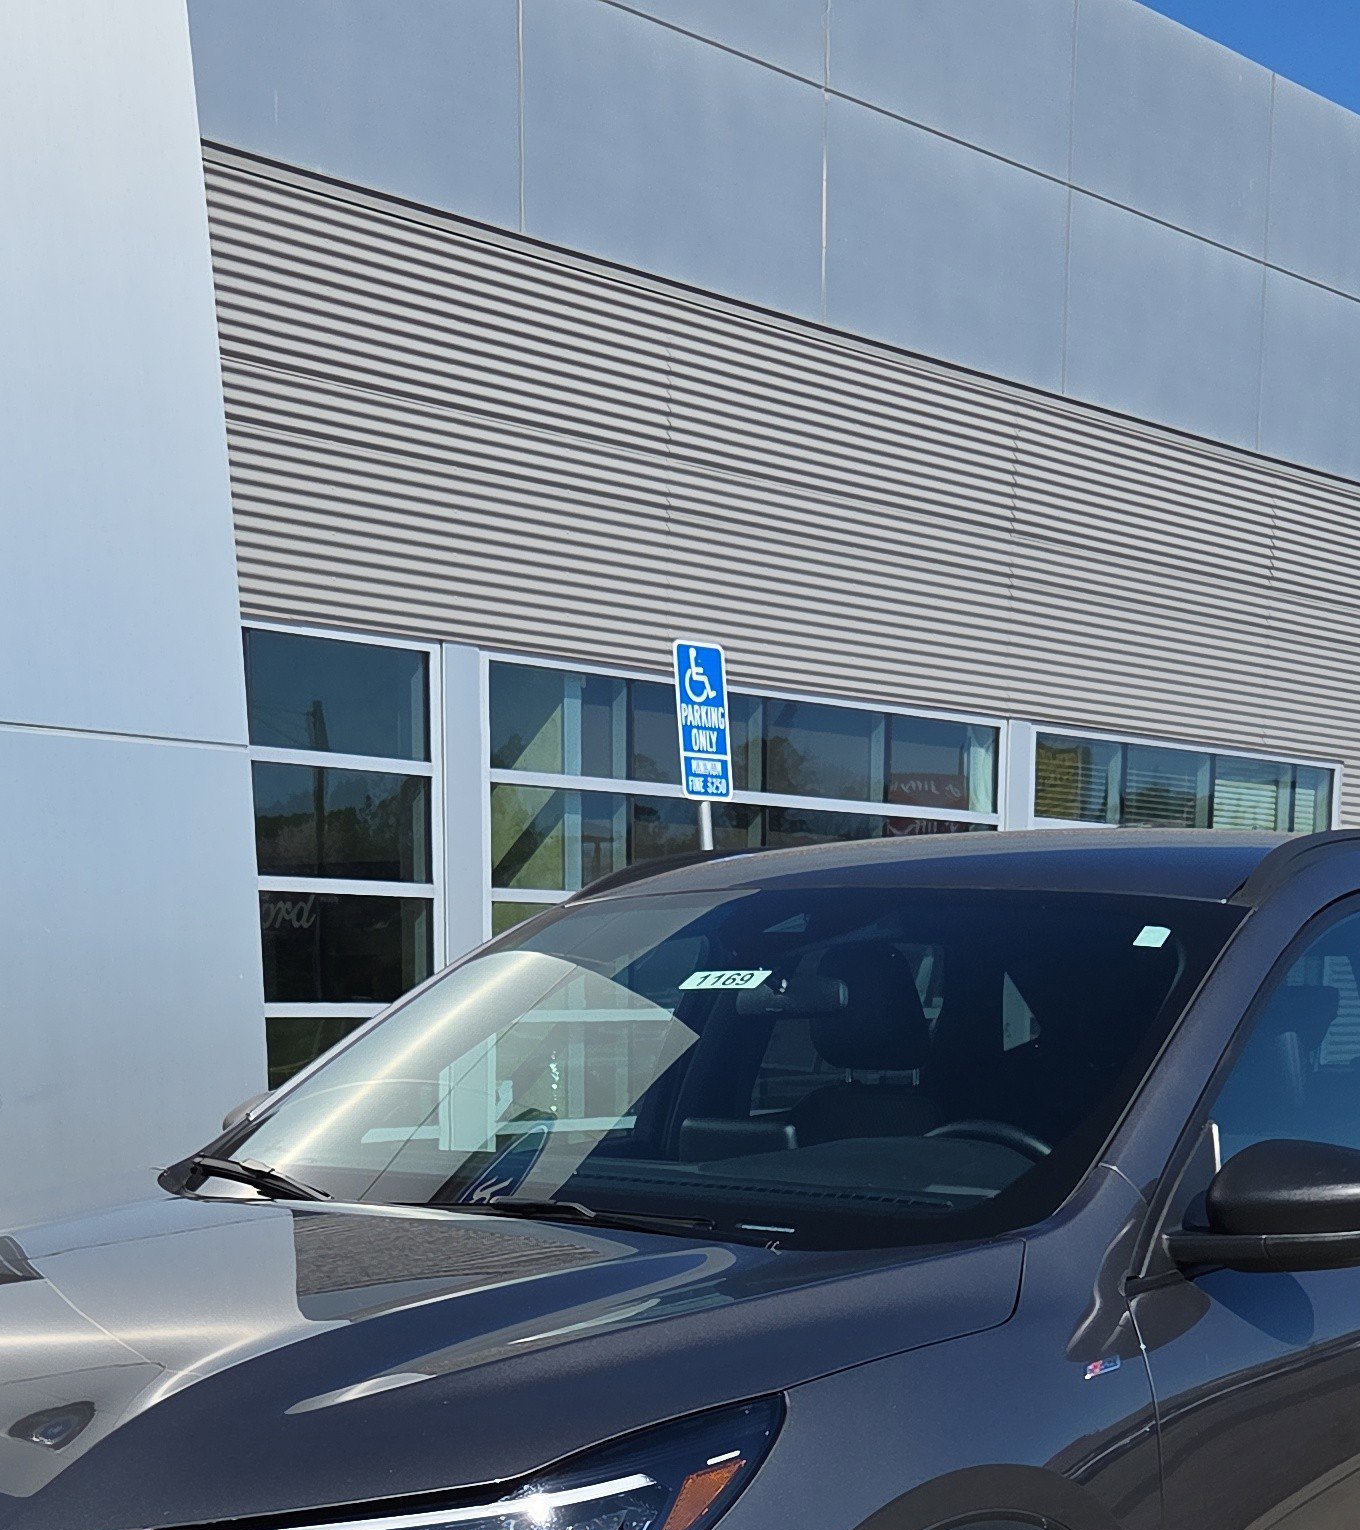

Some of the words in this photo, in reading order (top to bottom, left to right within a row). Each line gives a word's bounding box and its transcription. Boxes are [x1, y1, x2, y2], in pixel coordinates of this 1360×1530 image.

[681, 702, 725, 729] PARKING
[691, 728, 717, 752] ONLY
[261, 894, 316, 929] ord
[696, 972, 755, 987] 1169
